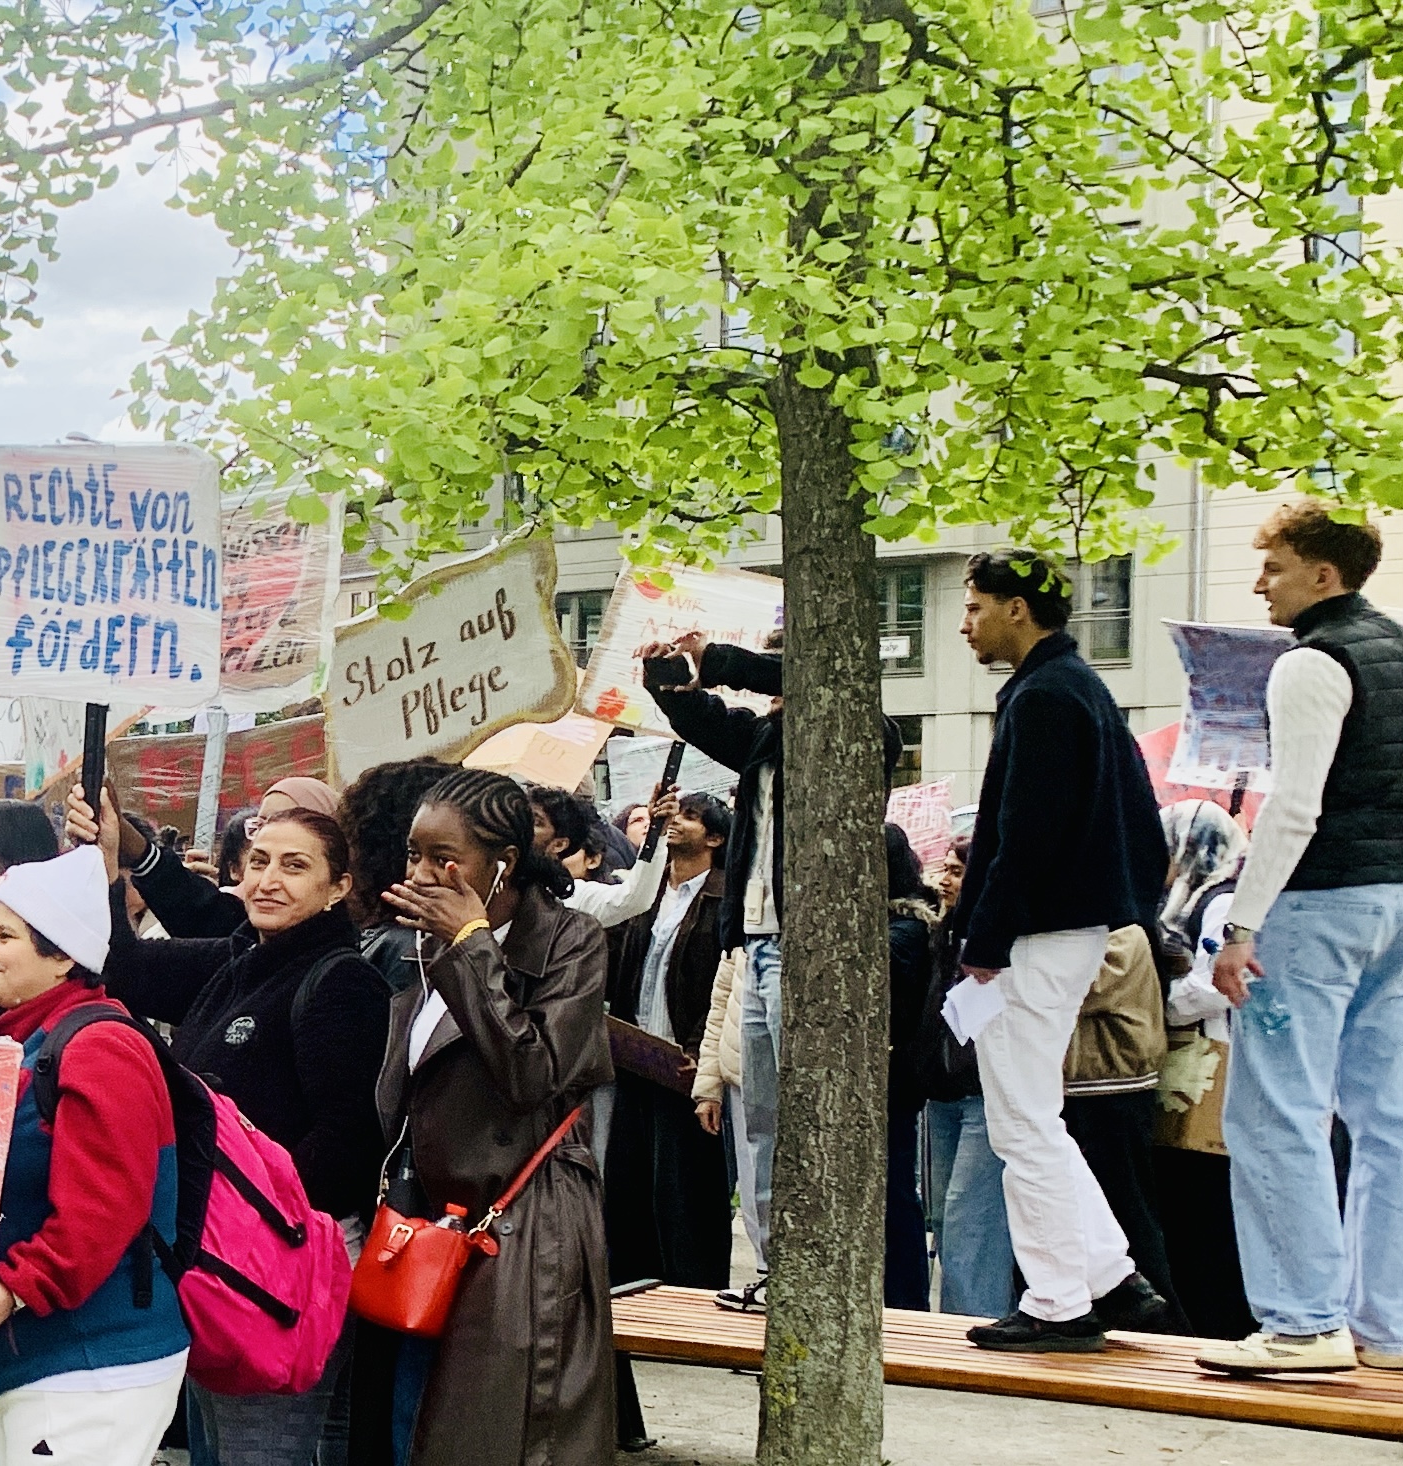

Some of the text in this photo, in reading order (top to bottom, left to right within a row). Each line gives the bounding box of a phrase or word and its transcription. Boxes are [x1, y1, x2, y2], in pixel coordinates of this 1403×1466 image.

[342, 636, 441, 707] Stolz
[459, 587, 517, 642] auf
[400, 663, 509, 740] Pflege
